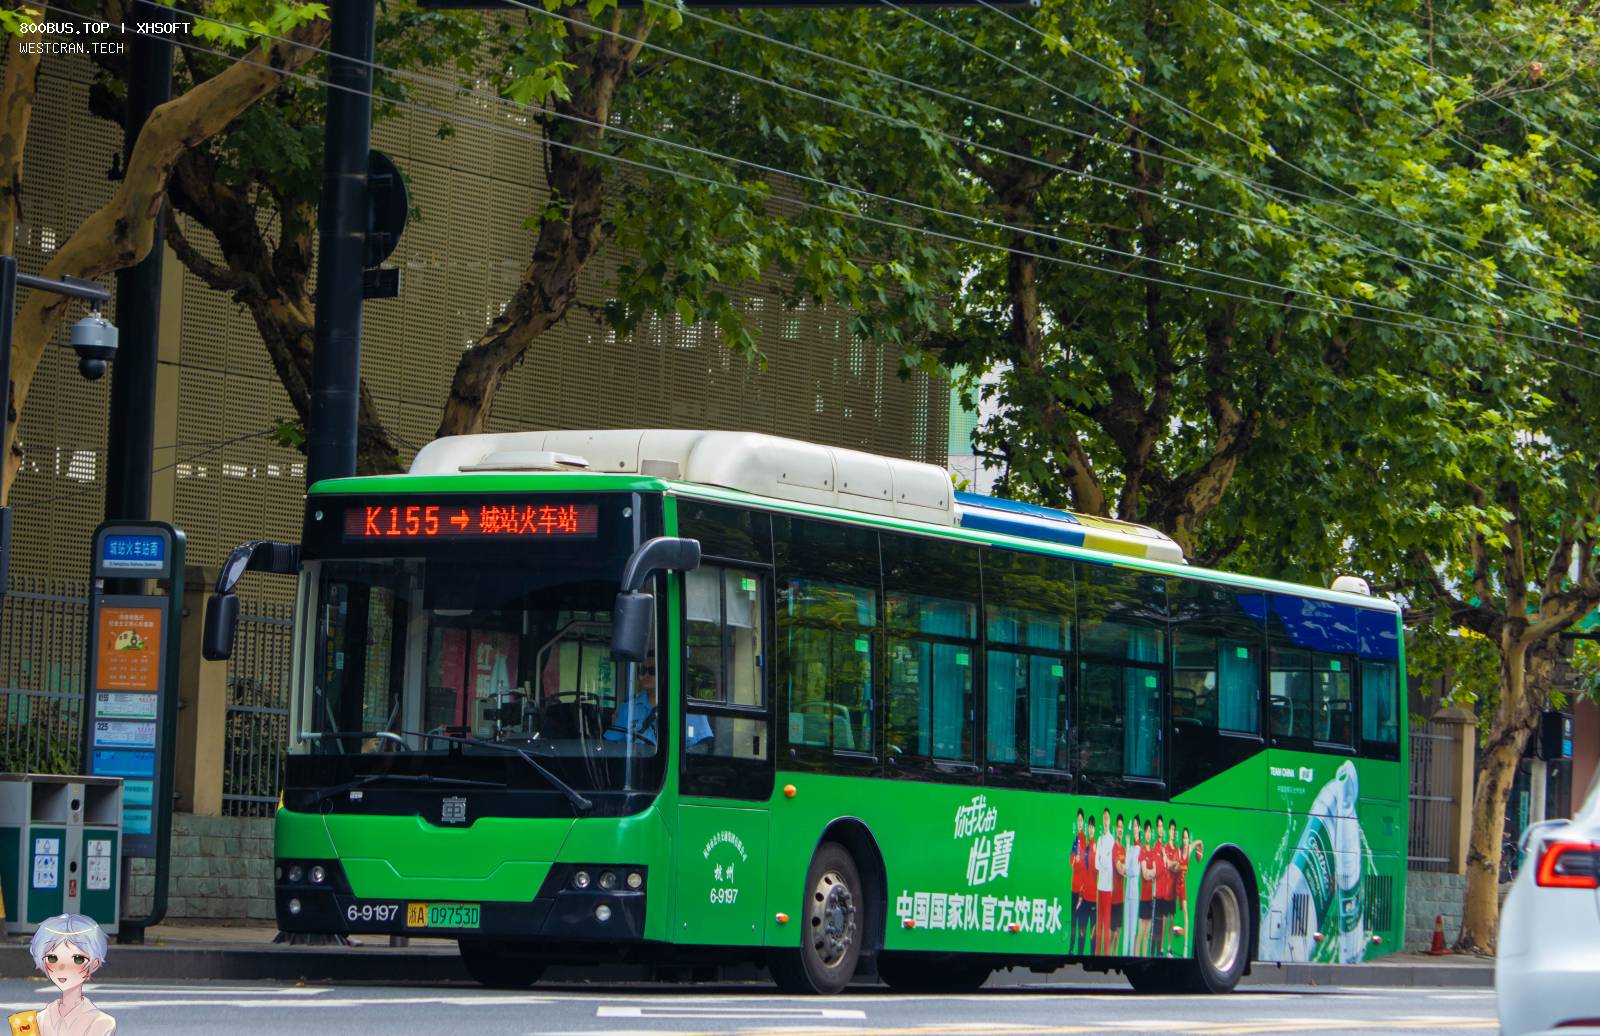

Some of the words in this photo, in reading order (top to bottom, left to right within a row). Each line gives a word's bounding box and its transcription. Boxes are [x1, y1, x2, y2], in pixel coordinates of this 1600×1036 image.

[364, 506, 440, 536] K155
[479, 504, 578, 535] 城站火车站
[954, 794, 998, 839] 你我的
[966, 830, 1016, 886] 怡寶
[710, 888, 739, 904] 6-9197
[347, 904, 399, 921] 6-9197
[431, 907, 479, 925] 09753D
[896, 890, 1063, 934] 中国国家队官方饮用水
